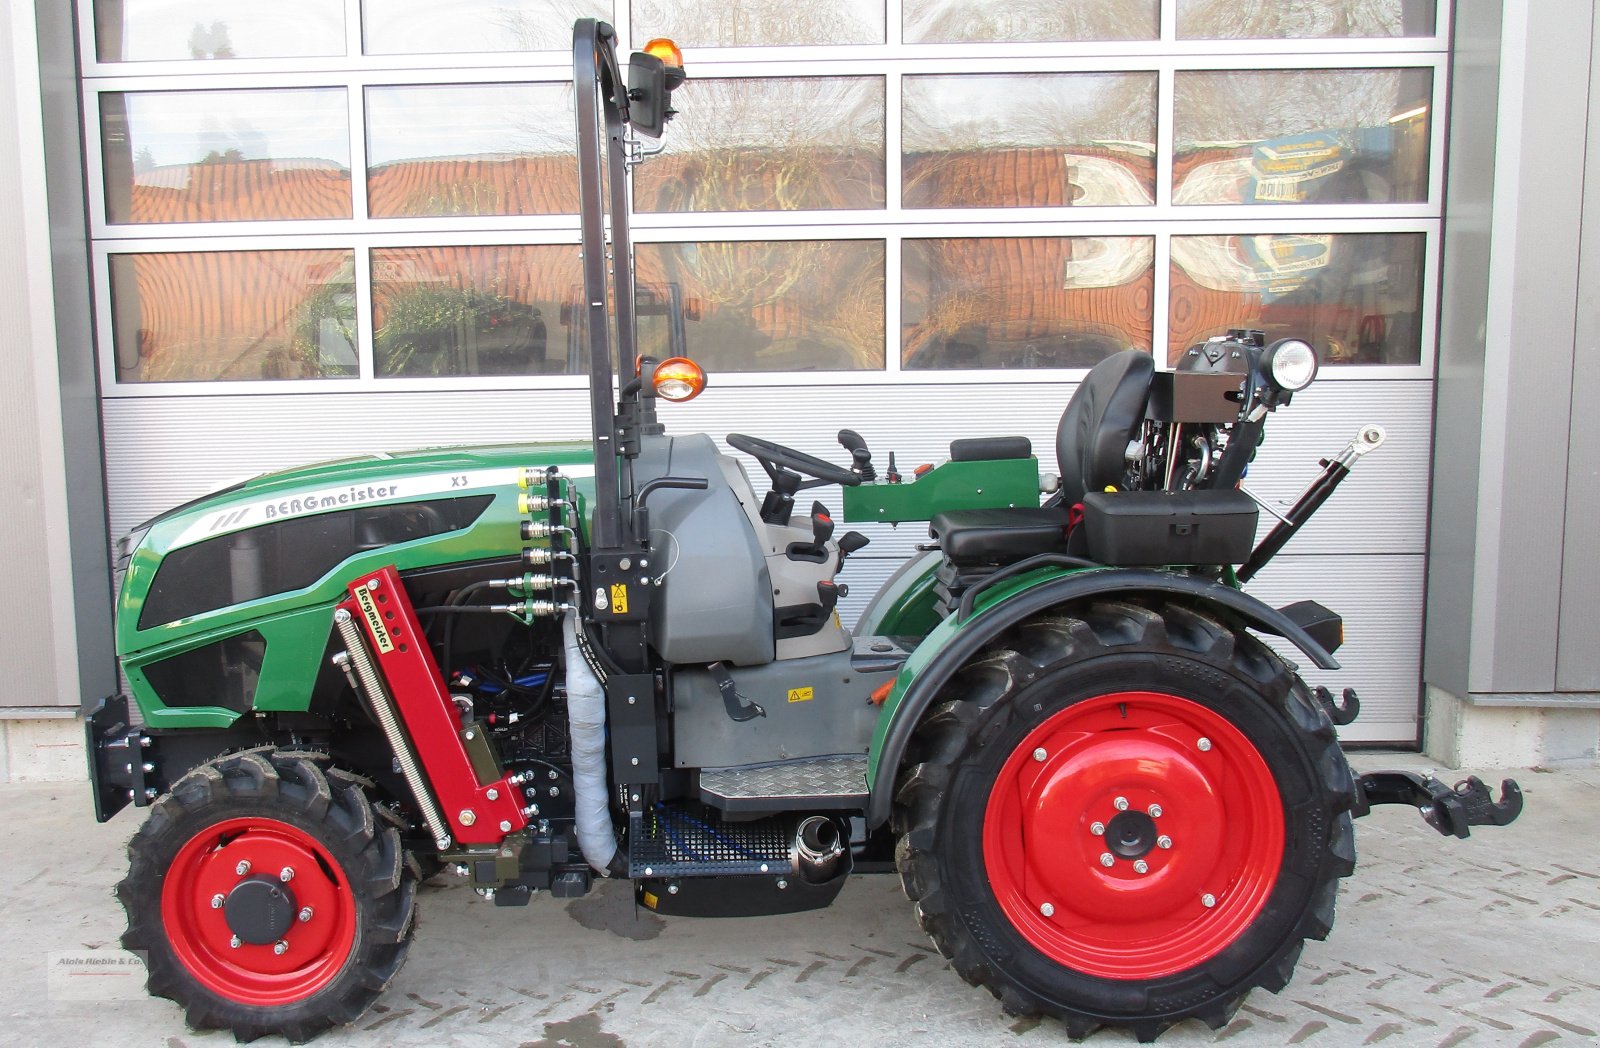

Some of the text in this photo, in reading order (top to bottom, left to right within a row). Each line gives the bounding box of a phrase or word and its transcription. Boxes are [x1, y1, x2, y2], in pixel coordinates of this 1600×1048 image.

[265, 475, 469, 519] BERGmeister X3
[358, 587, 390, 649] Bergmeister
